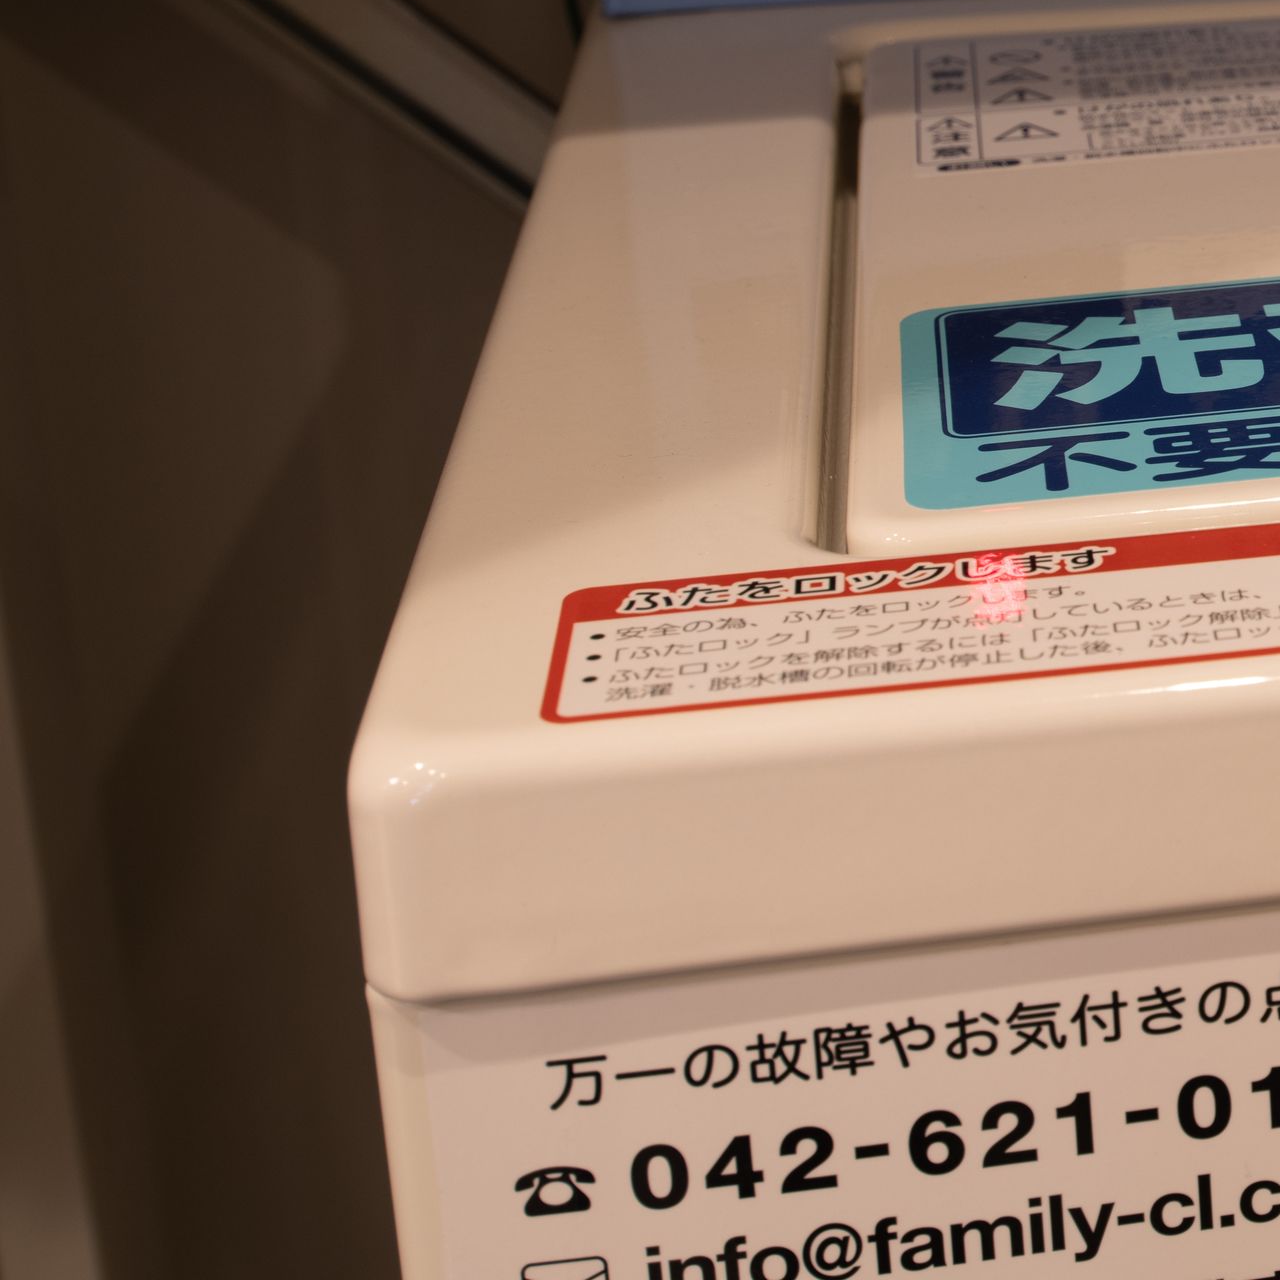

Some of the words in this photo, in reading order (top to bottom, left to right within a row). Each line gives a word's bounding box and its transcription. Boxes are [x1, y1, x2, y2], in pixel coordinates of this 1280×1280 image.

[624, 548, 1111, 613] ふたをロックします
